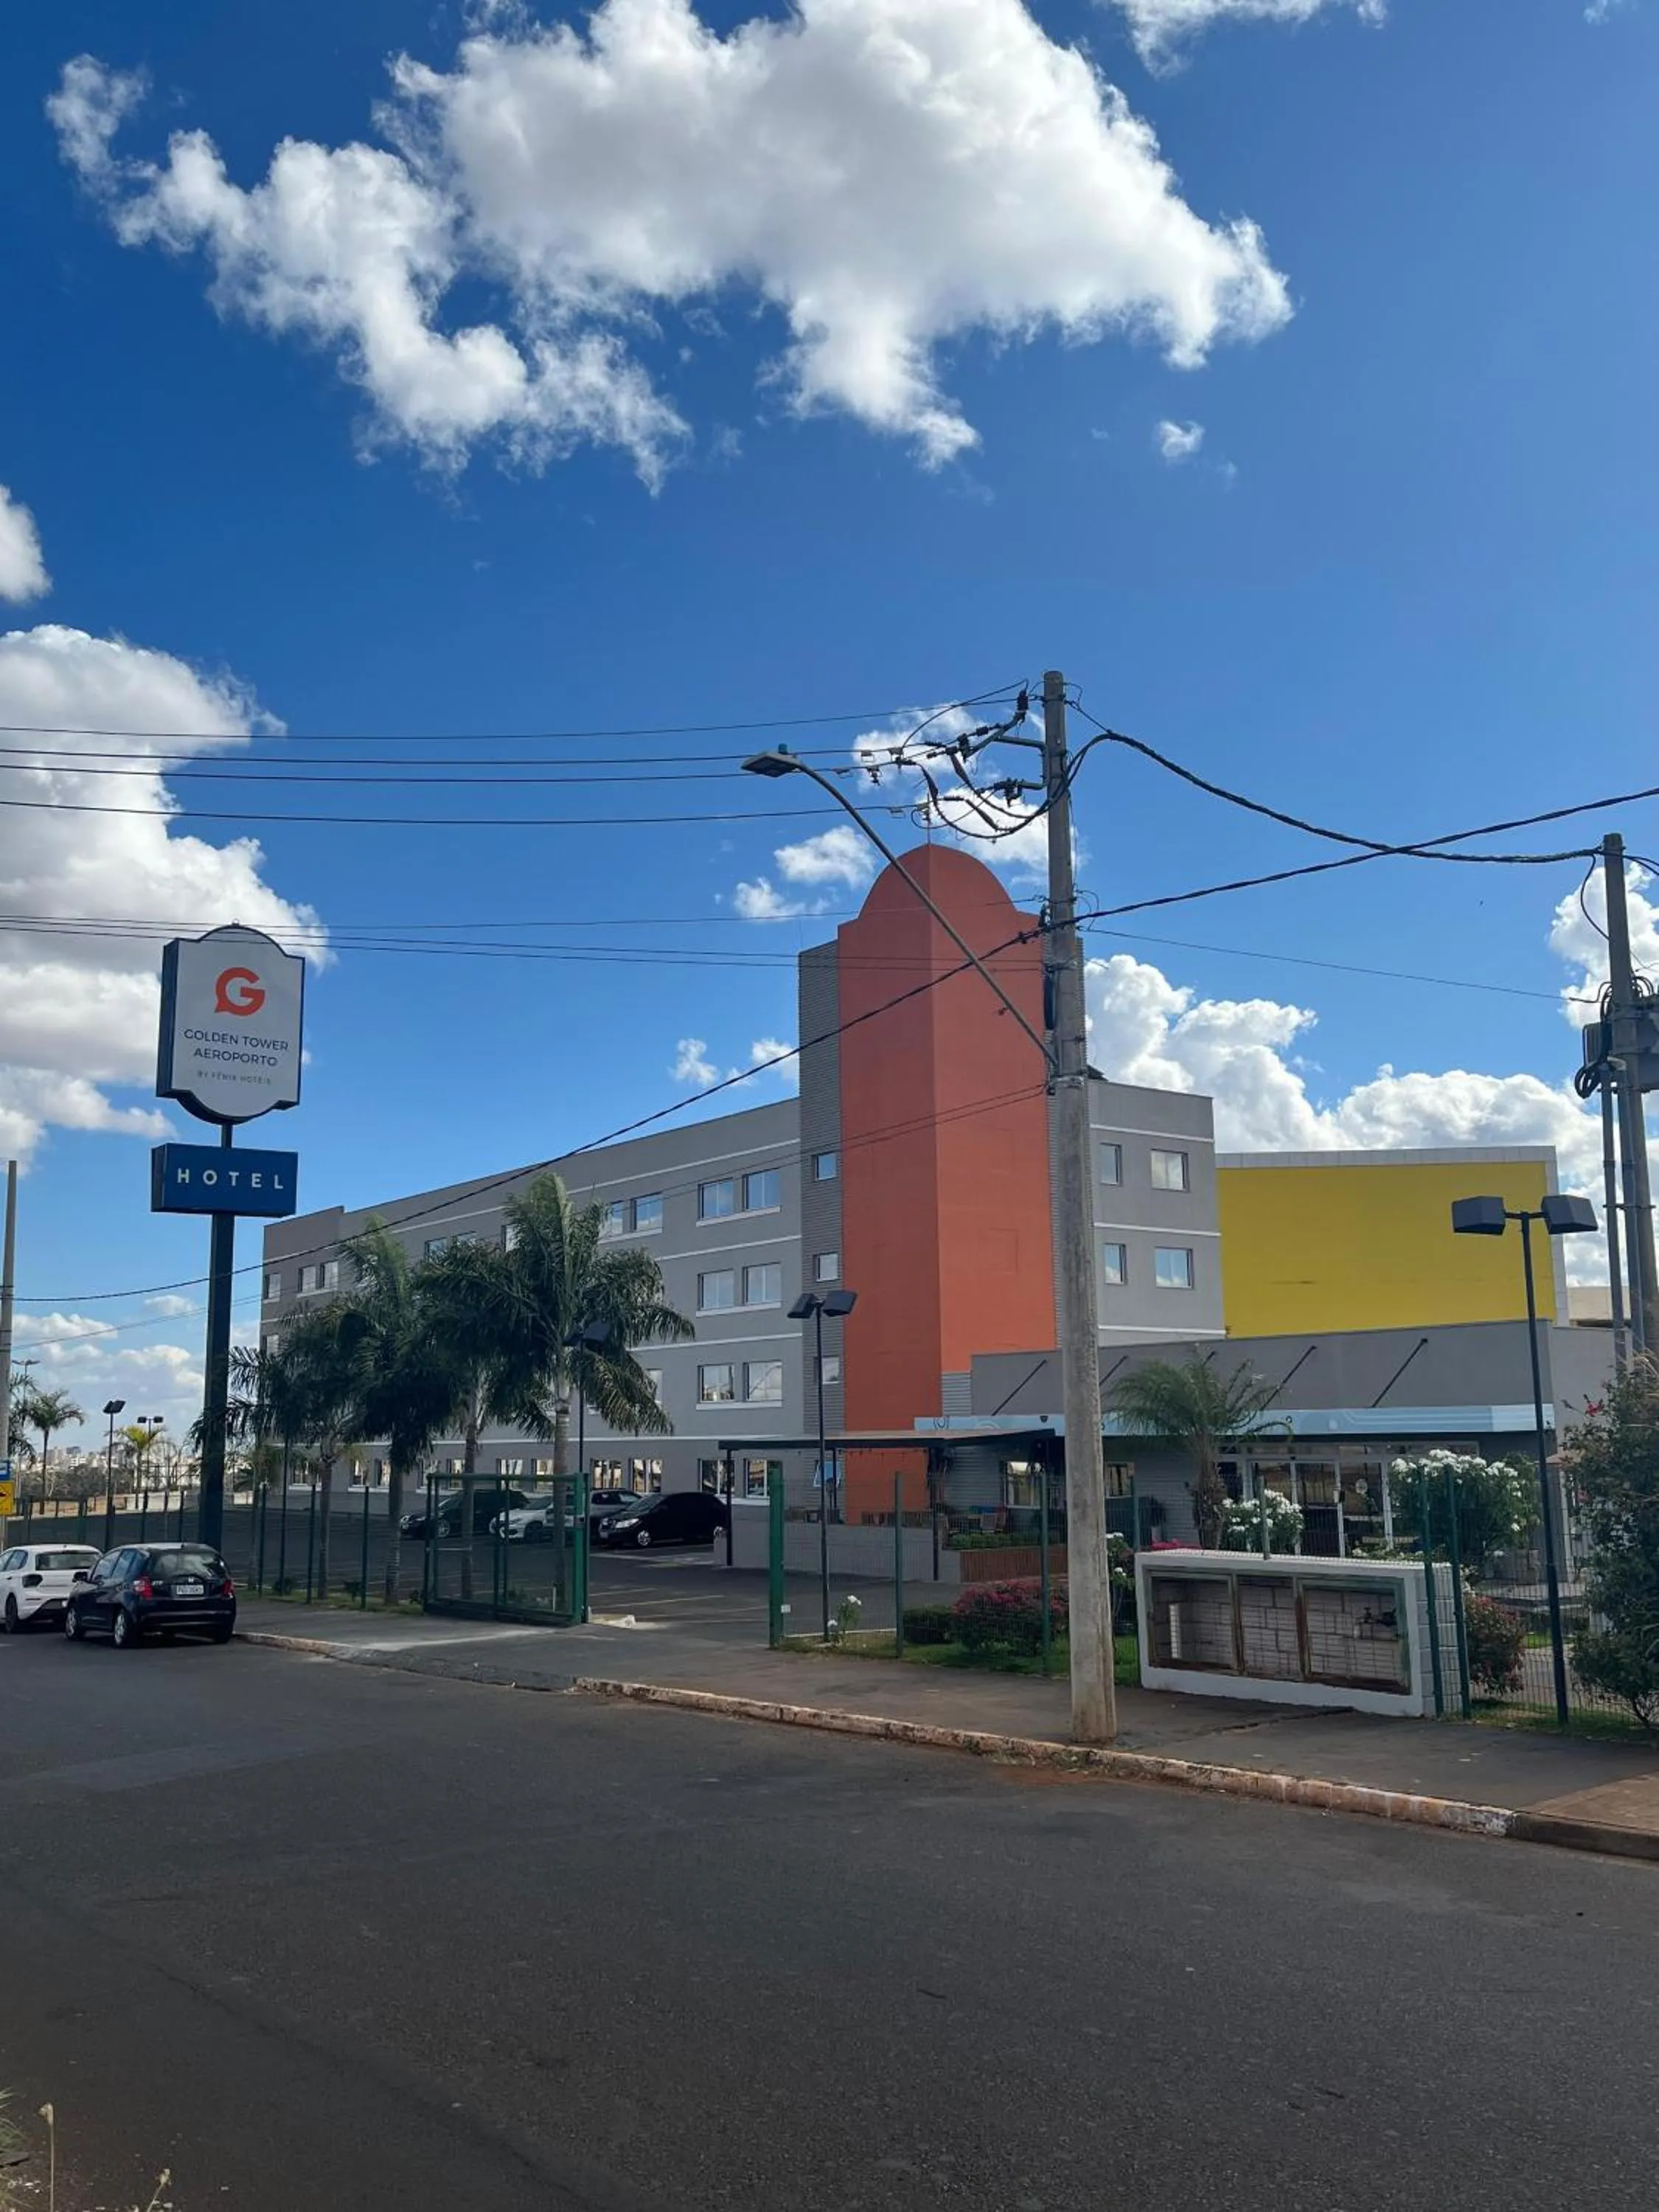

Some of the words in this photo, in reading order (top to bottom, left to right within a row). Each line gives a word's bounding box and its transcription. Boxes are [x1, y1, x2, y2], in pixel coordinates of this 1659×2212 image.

[214, 967, 265, 1016] G
[184, 1029, 238, 1046] GOLDEN
[242, 1036, 289, 1051] TOWER
[193, 1048, 279, 1067] AEROPORTO
[177, 1168, 284, 1189] HOTEL
